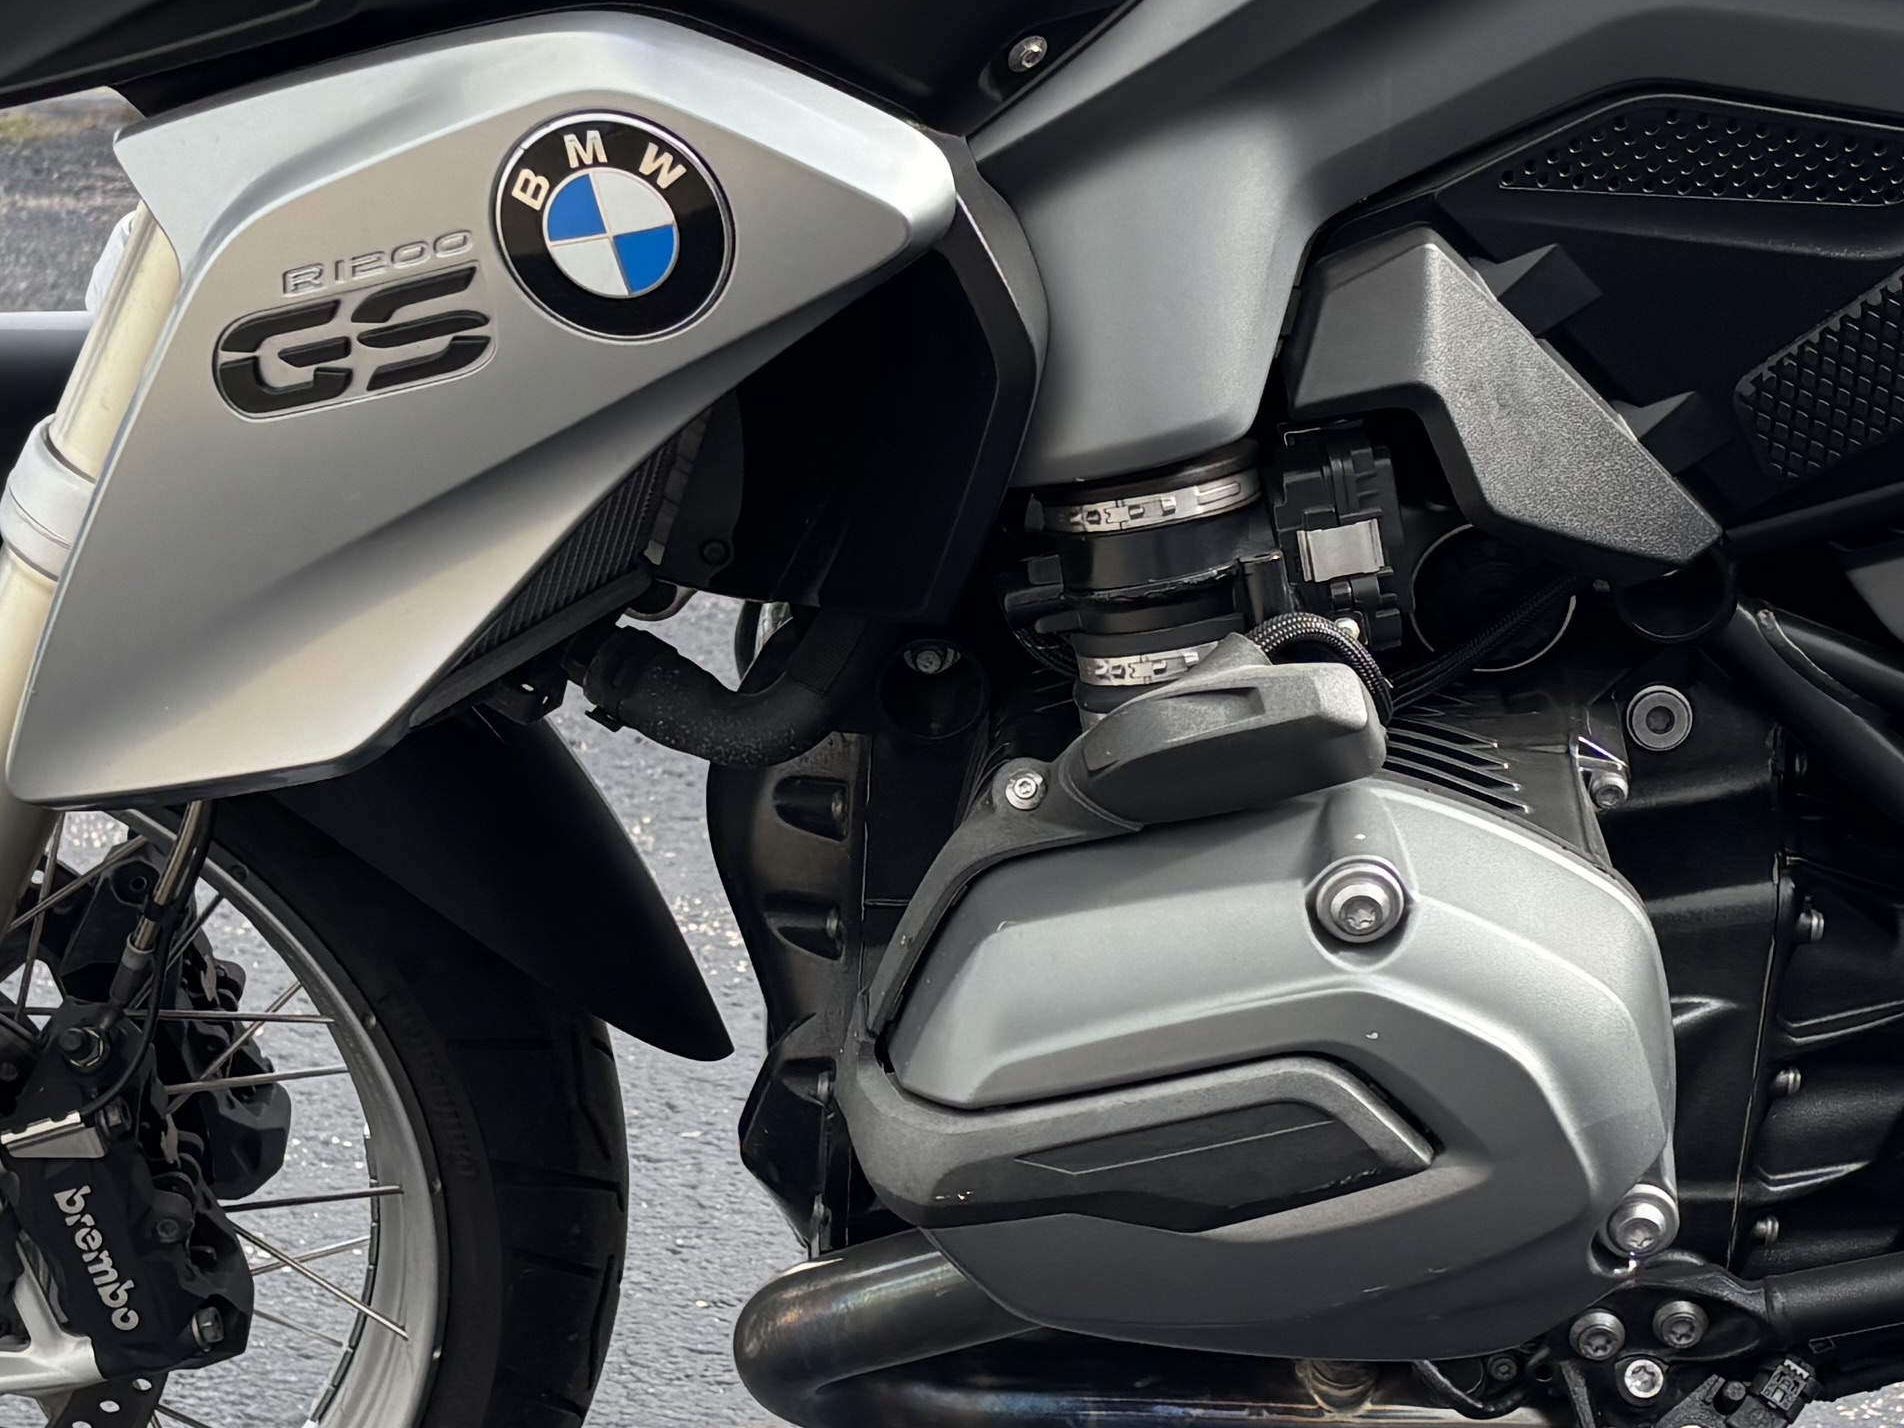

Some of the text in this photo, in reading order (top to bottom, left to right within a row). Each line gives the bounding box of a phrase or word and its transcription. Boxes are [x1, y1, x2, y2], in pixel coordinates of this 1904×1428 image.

[512, 130, 687, 211] BMW
[215, 263, 495, 419] GS
[54, 1184, 140, 1332] brembo
